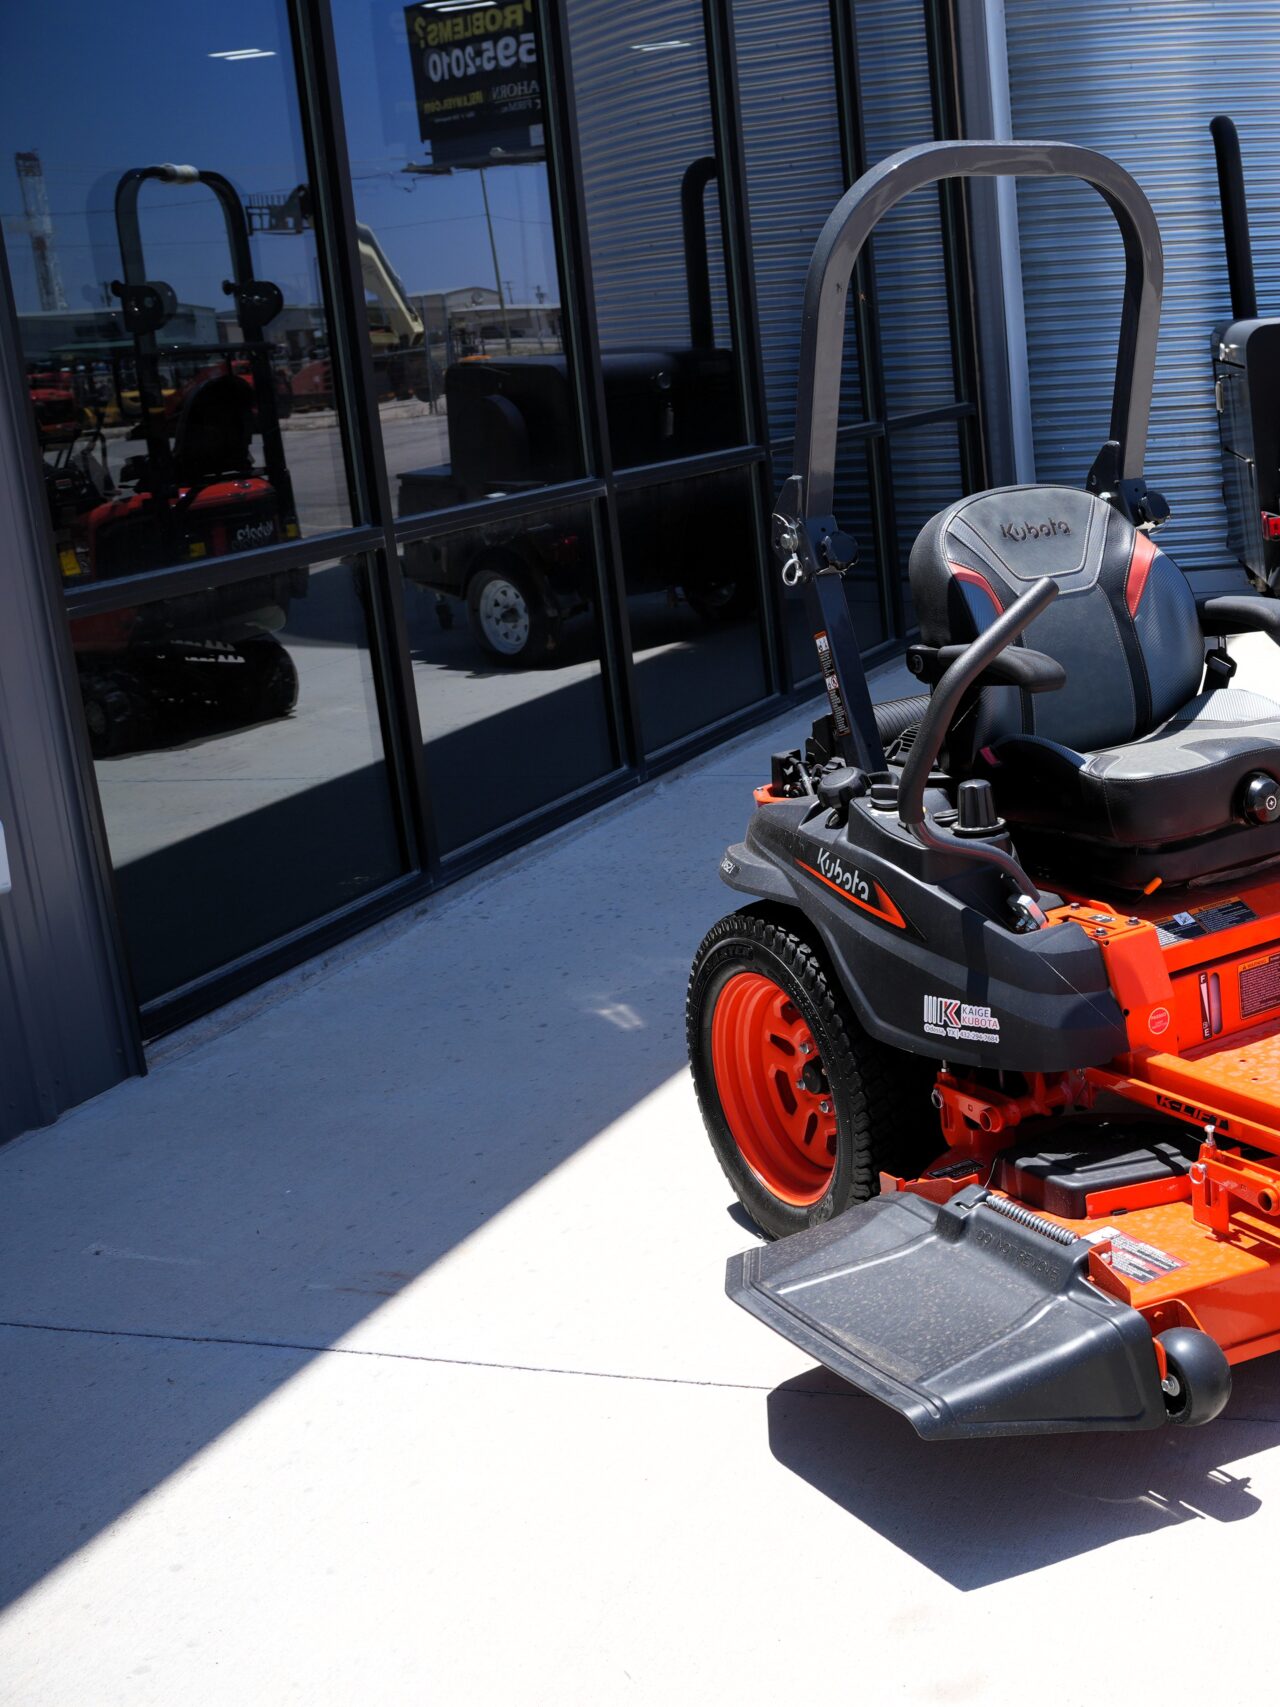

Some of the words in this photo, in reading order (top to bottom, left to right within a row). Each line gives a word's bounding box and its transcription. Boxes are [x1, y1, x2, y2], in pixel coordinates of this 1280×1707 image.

[1000, 517, 1071, 542] Kubota
[817, 847, 869, 901] Kubota
[962, 1007, 990, 1018] KAIGE
[962, 1016, 999, 1029] KUBOTA
